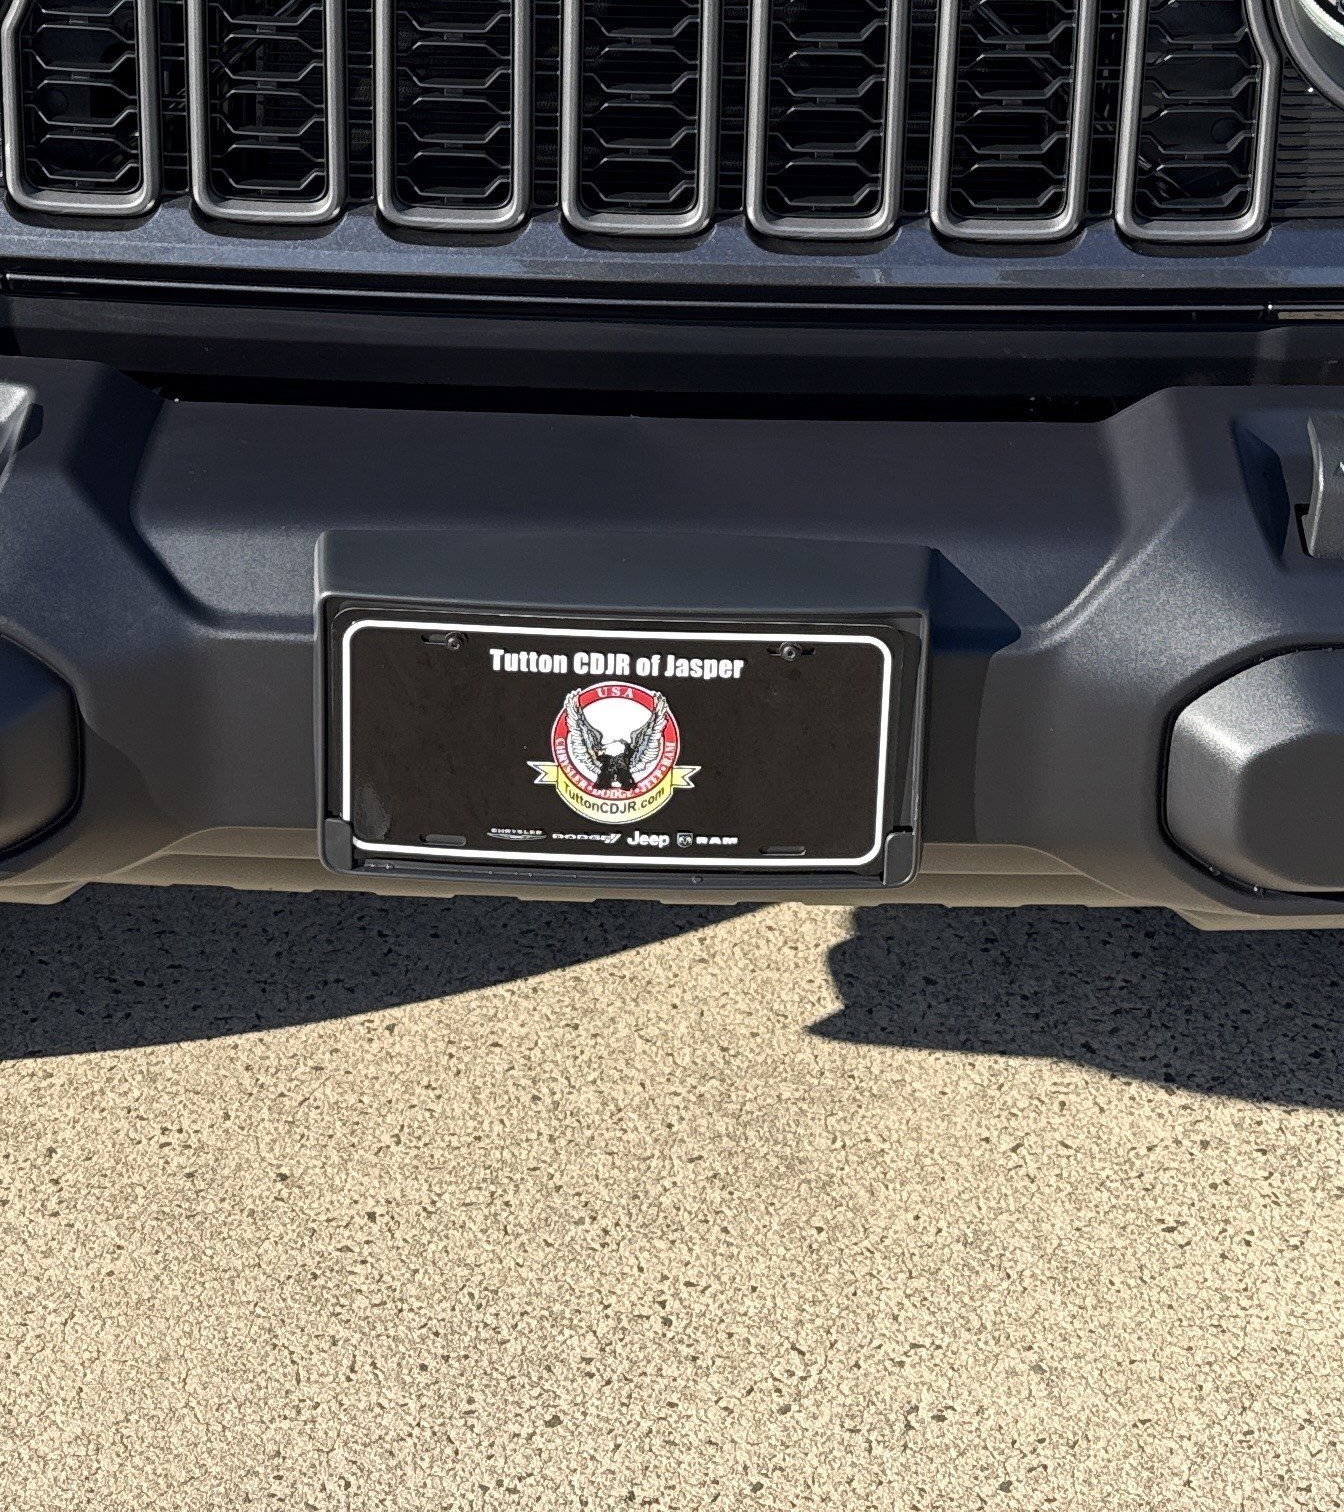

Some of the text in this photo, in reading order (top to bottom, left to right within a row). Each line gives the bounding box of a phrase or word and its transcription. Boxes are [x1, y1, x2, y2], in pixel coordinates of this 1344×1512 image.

[489, 648, 744, 680] Tutton CDJR of Jasper
[596, 687, 634, 698] USA
[563, 781, 665, 814] TuttonCDJR.com
[491, 827, 543, 835] CHRYSLER
[627, 830, 670, 848] Jeep
[696, 836, 738, 845] RAM
